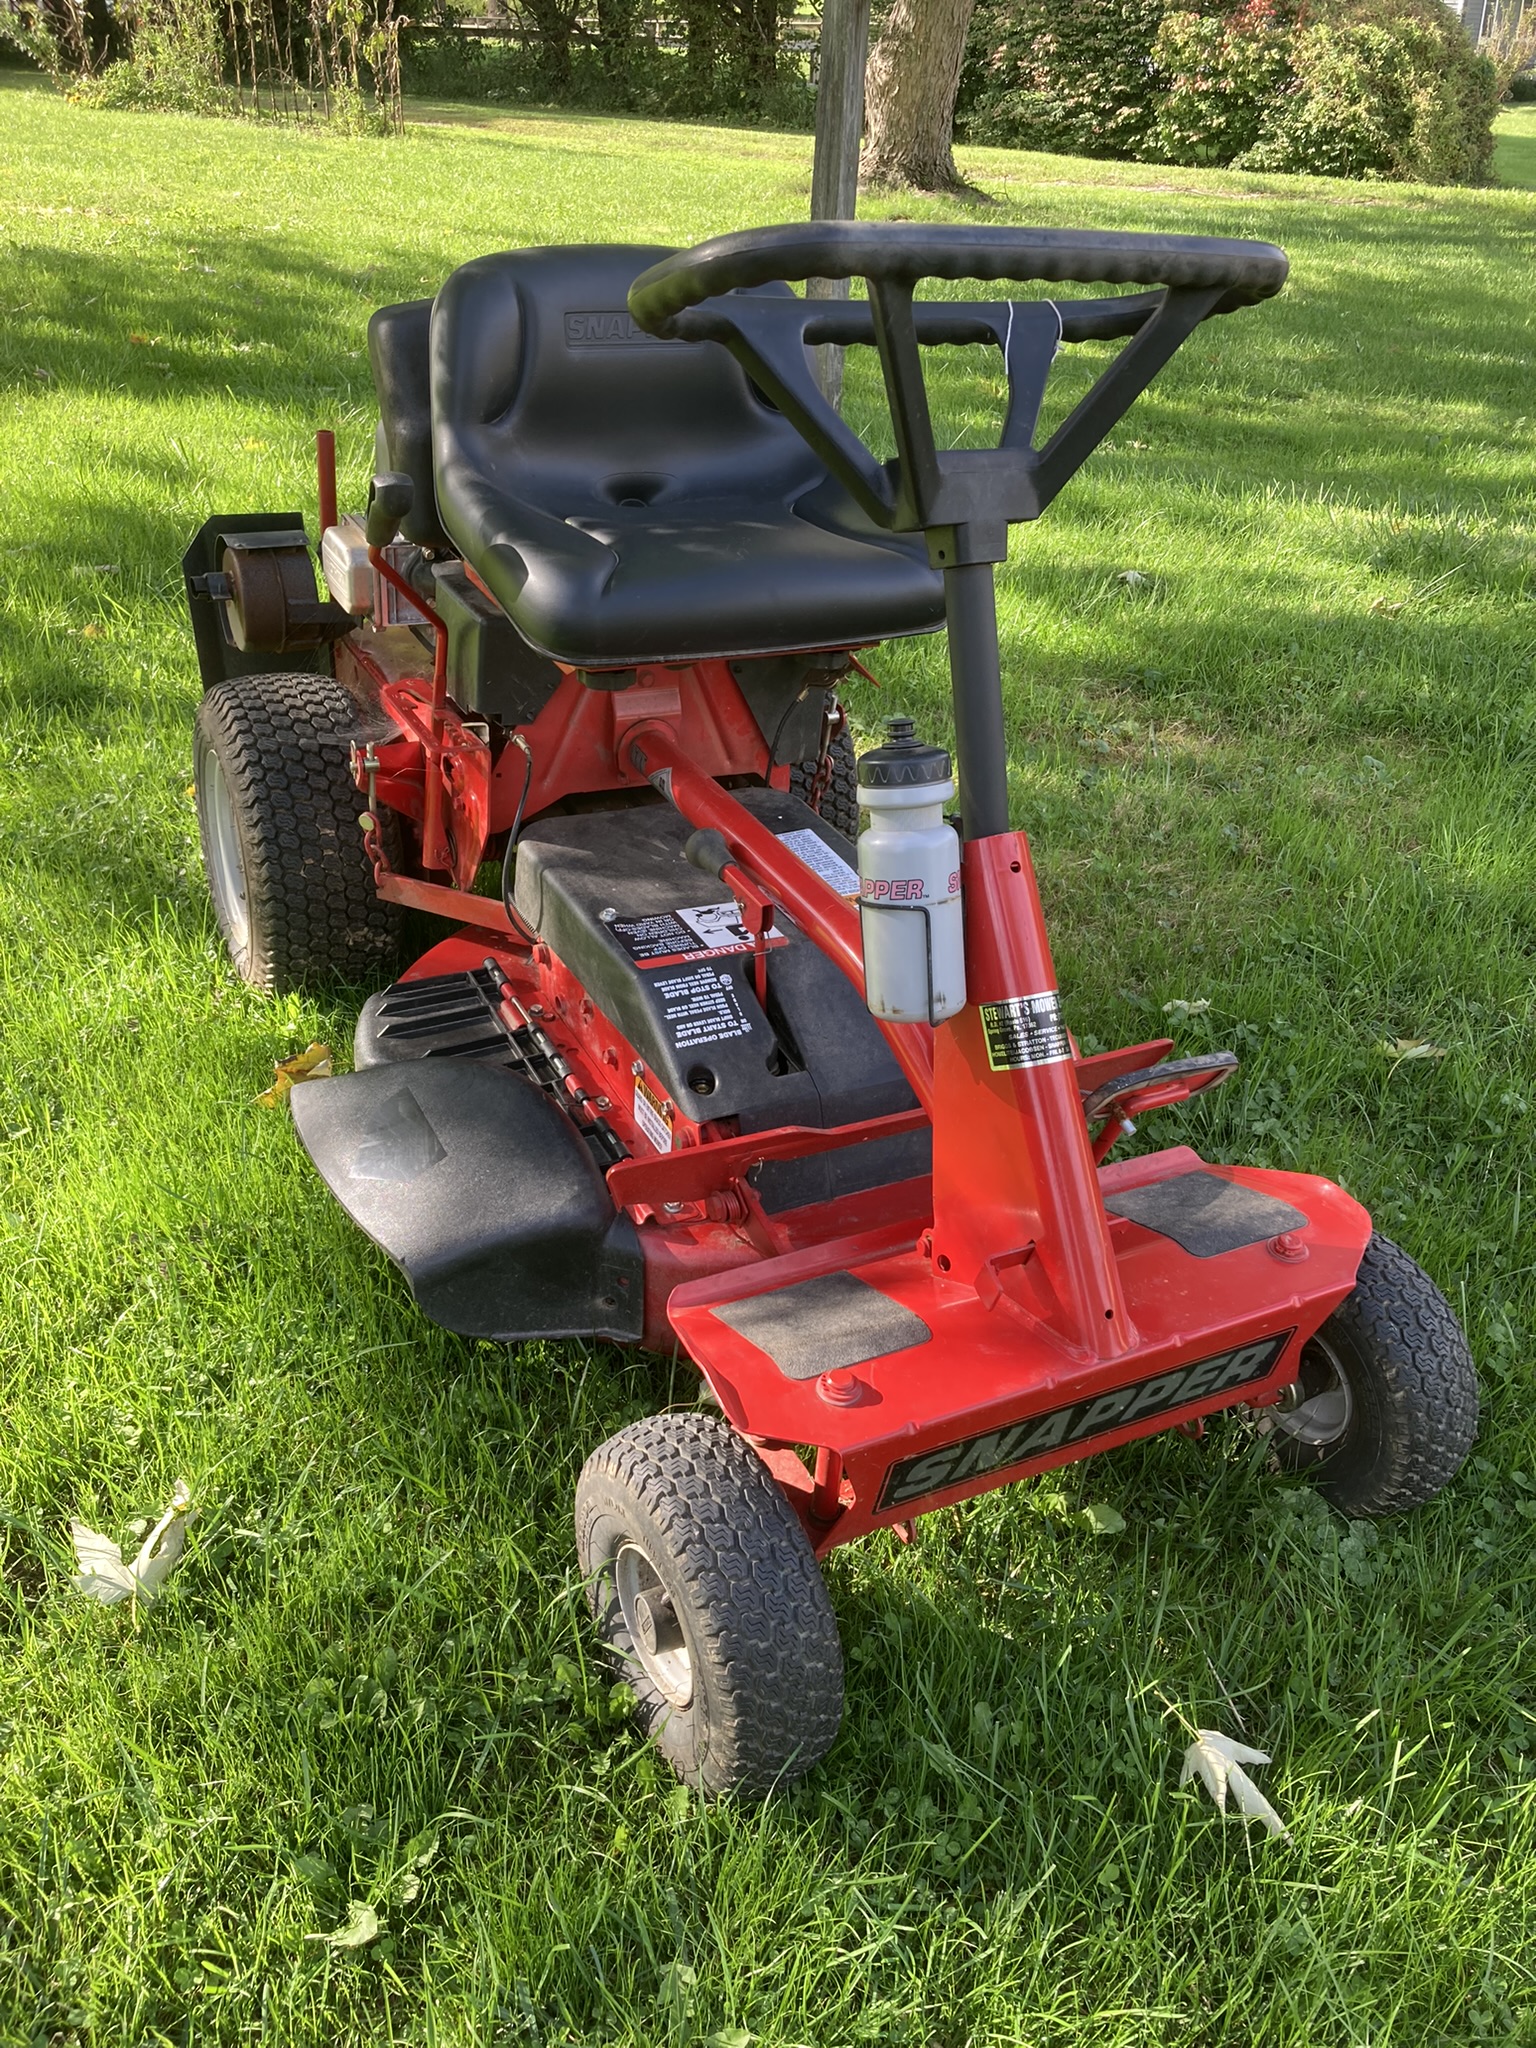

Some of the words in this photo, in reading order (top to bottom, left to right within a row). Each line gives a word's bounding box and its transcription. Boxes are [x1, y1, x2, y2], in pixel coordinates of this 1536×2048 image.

[682, 944, 746, 960] DANGER
[663, 989, 689, 998] BLADE
[689, 984, 710, 993] STOP
[984, 1002, 1030, 1021] STEWART'S
[675, 1027, 702, 1037] BLADE
[701, 1022, 727, 1032] START
[717, 1029, 742, 1039] BLADE
[1009, 1032, 1028, 1040] SALES
[1034, 1027, 1057, 1035] SERVICE
[674, 1034, 718, 1048] OPERATION
[1017, 1037, 1046, 1047] STRATTON
[893, 1340, 1278, 1500] SNAPPER
